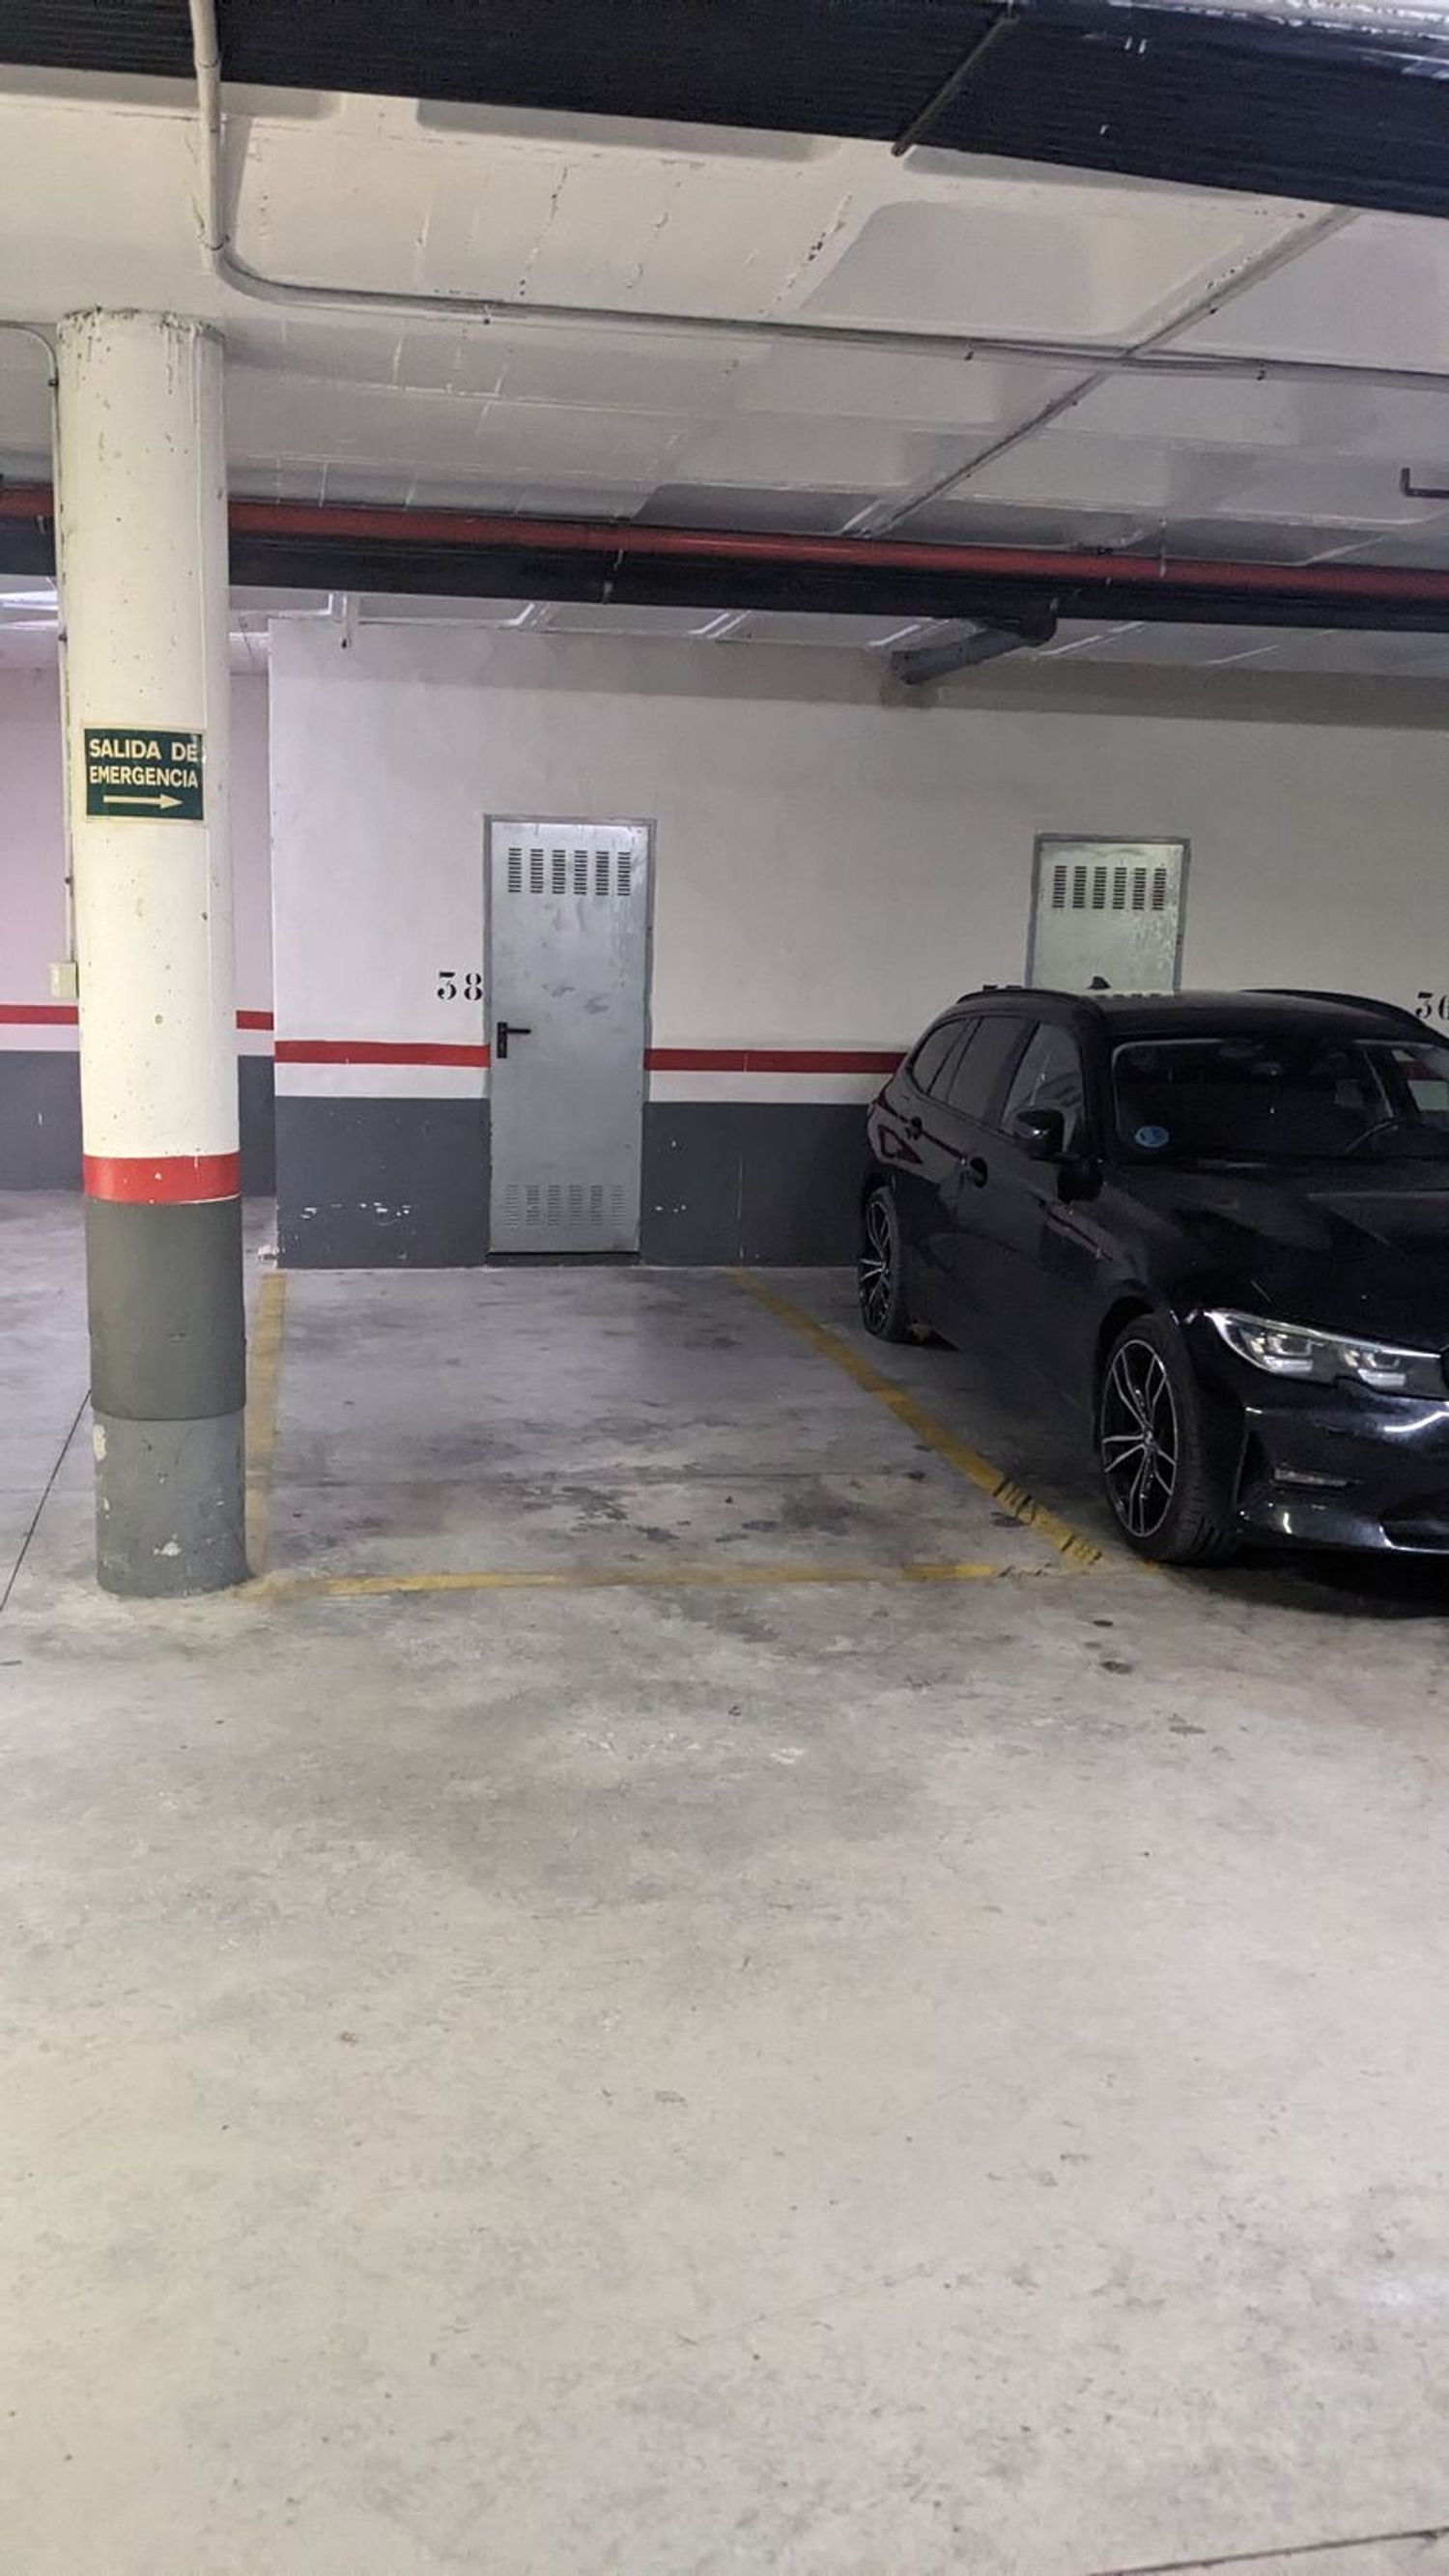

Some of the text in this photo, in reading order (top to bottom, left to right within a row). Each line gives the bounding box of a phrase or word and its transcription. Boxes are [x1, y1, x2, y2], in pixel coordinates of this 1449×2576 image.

[89, 738, 199, 762] SALIDA DE
[89, 765, 199, 788] EMERGENCIA
[437, 971, 483, 1001] 38
